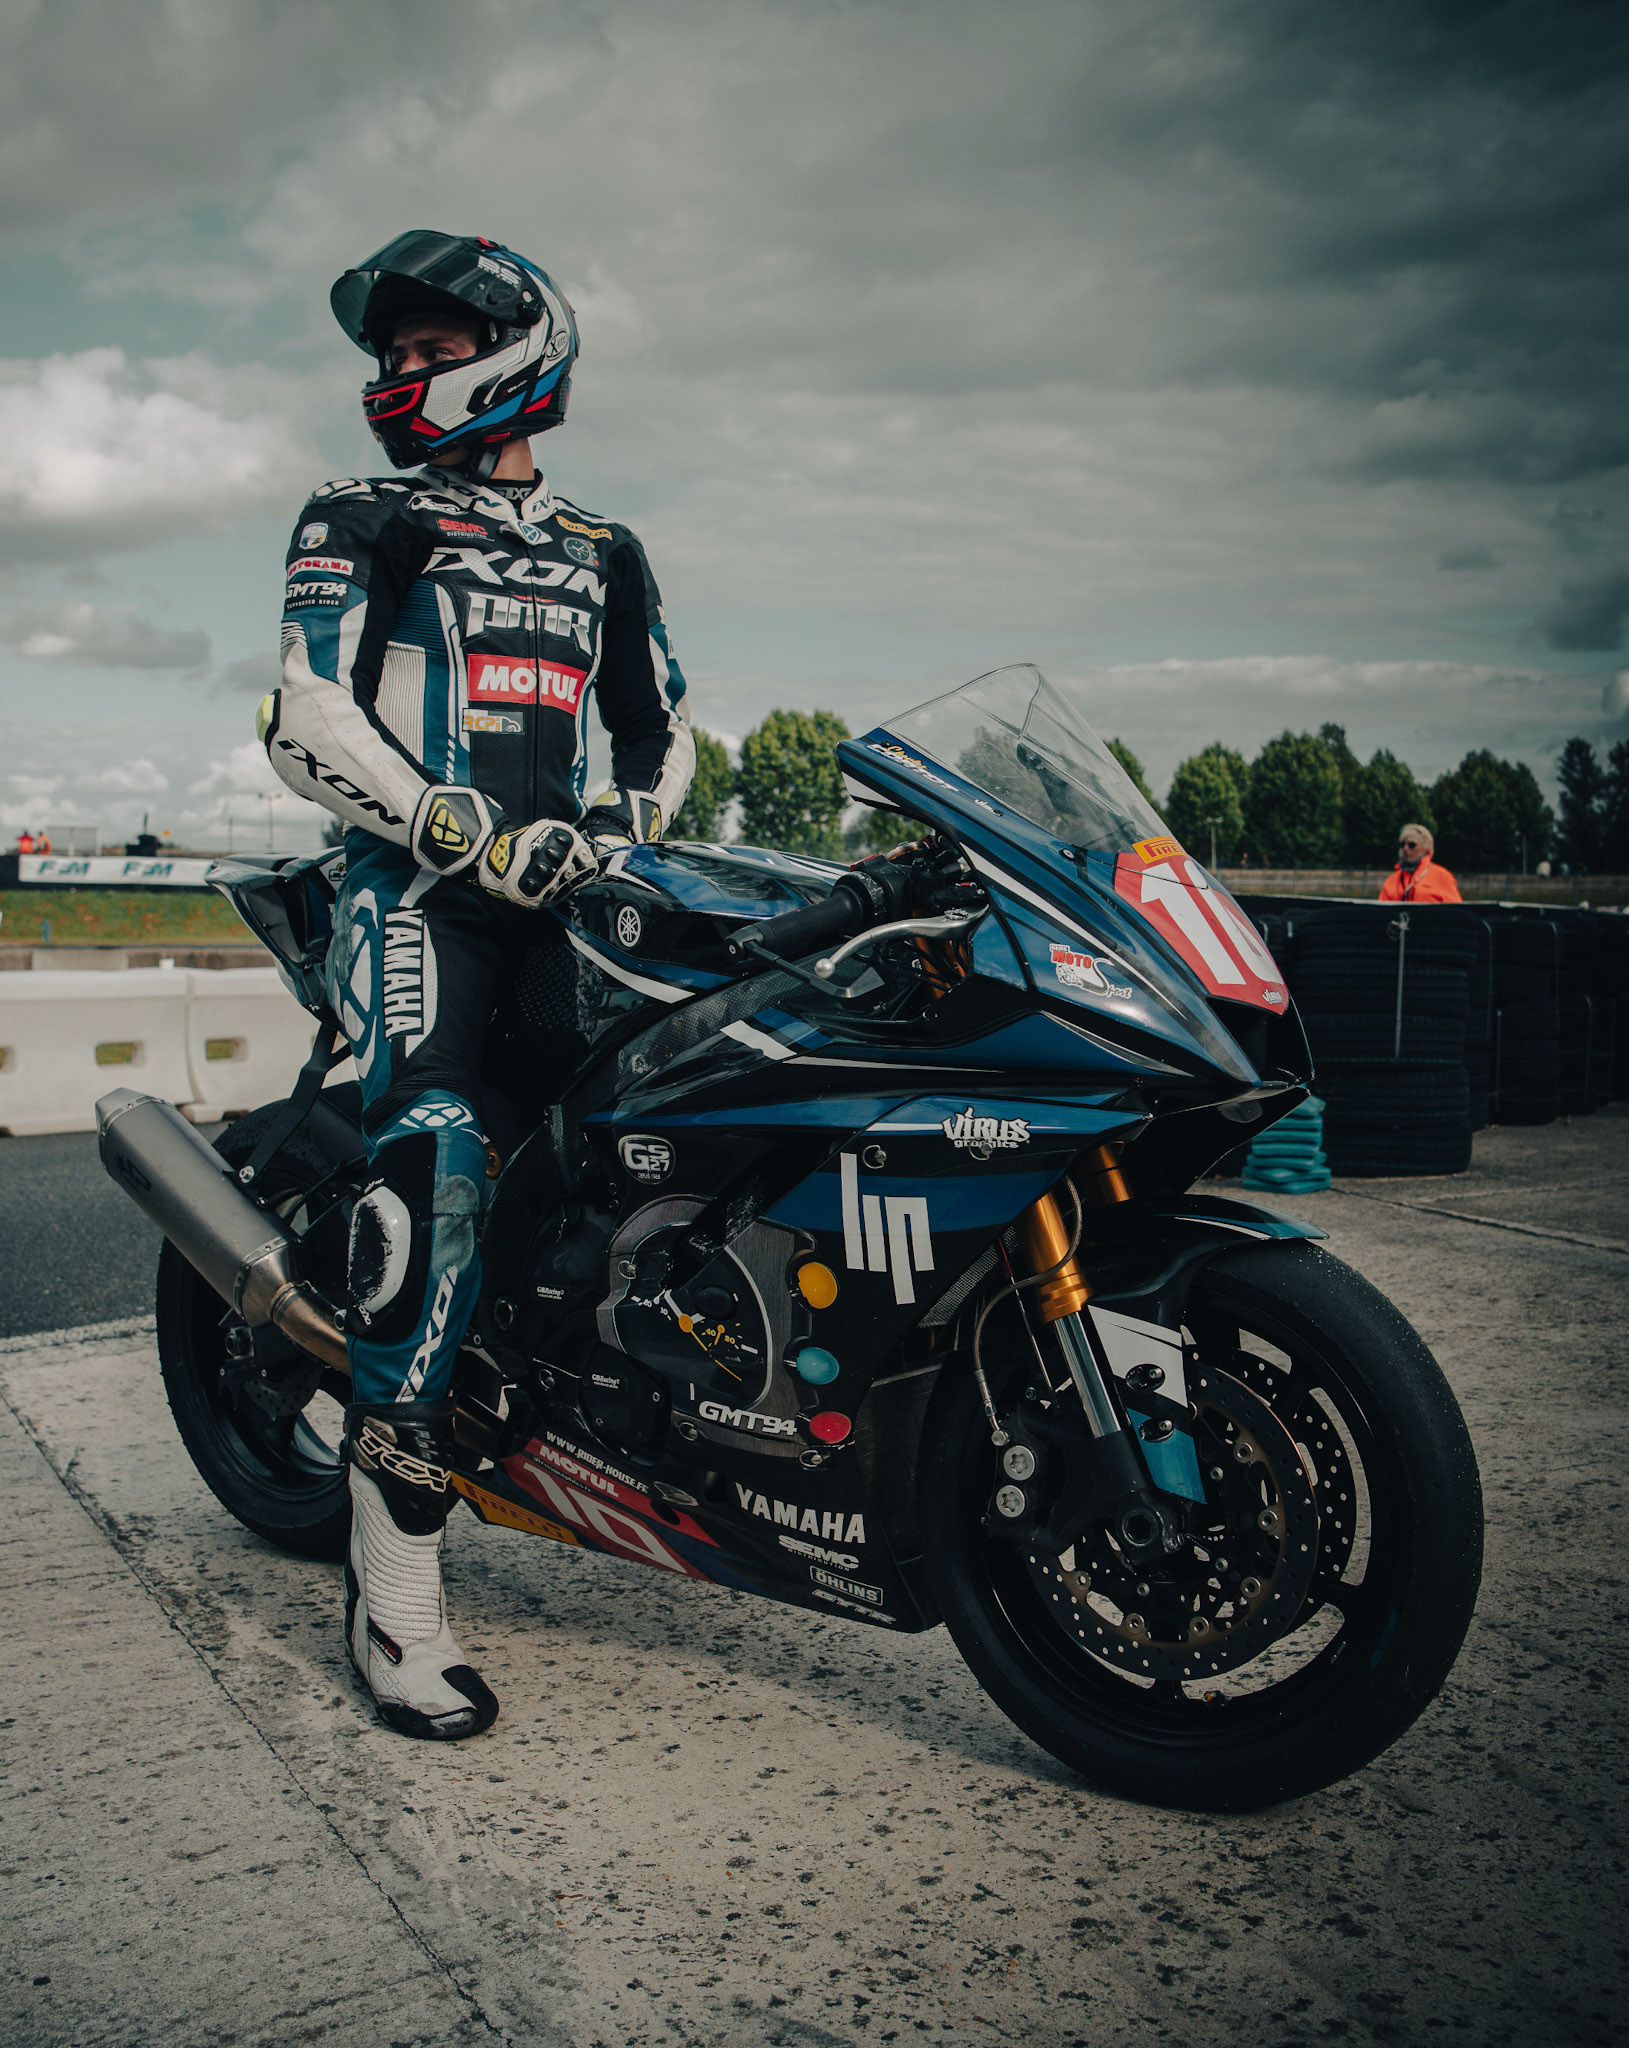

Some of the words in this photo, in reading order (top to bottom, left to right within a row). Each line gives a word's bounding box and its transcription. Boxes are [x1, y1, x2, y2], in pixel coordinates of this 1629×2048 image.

[438, 518, 489, 536] SEMC
[286, 582, 348, 599] GMT94
[477, 664, 579, 705] MOTUL
[1143, 838, 1184, 858] PIRE
[1140, 860, 1285, 985] 10
[384, 908, 424, 1039] YAMAHA
[1052, 950, 1093, 969] MOTO
[699, 1400, 798, 1436] GMT94
[539, 1444, 620, 1498] MOTUL
[523, 1462, 688, 1574] 10
[735, 1480, 866, 1544] YAMAHA
[777, 1534, 860, 1570] SEMC
[815, 1568, 879, 1602] ÖHLINS
